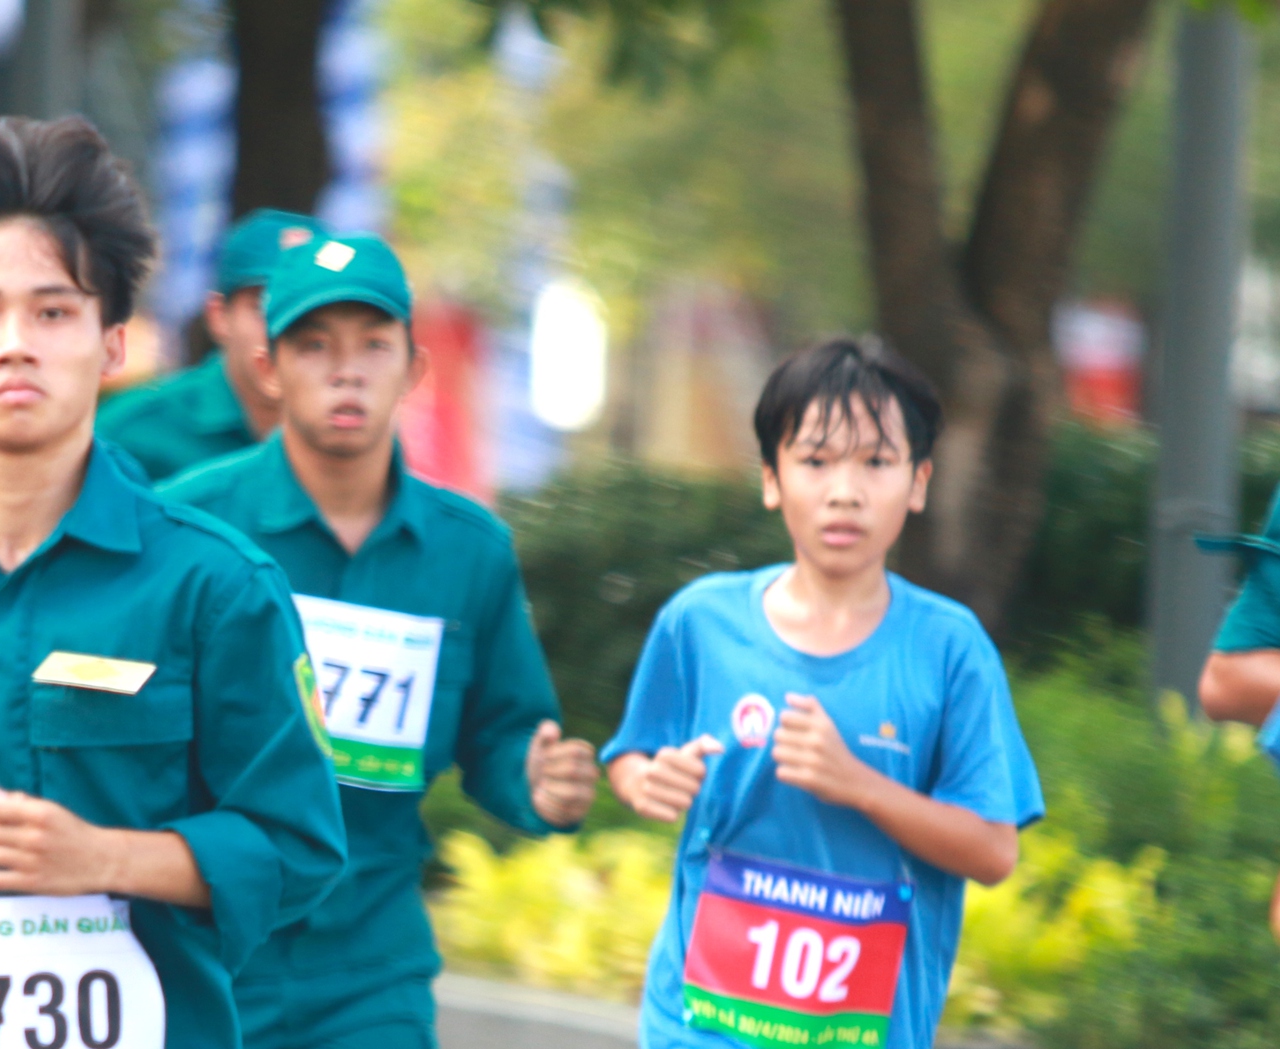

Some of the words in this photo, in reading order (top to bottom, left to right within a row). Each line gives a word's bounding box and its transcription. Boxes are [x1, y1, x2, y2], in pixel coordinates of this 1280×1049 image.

[742, 867, 828, 912] THANH
[22, 914, 68, 936] DÂN
[747, 920, 861, 1003] 102
